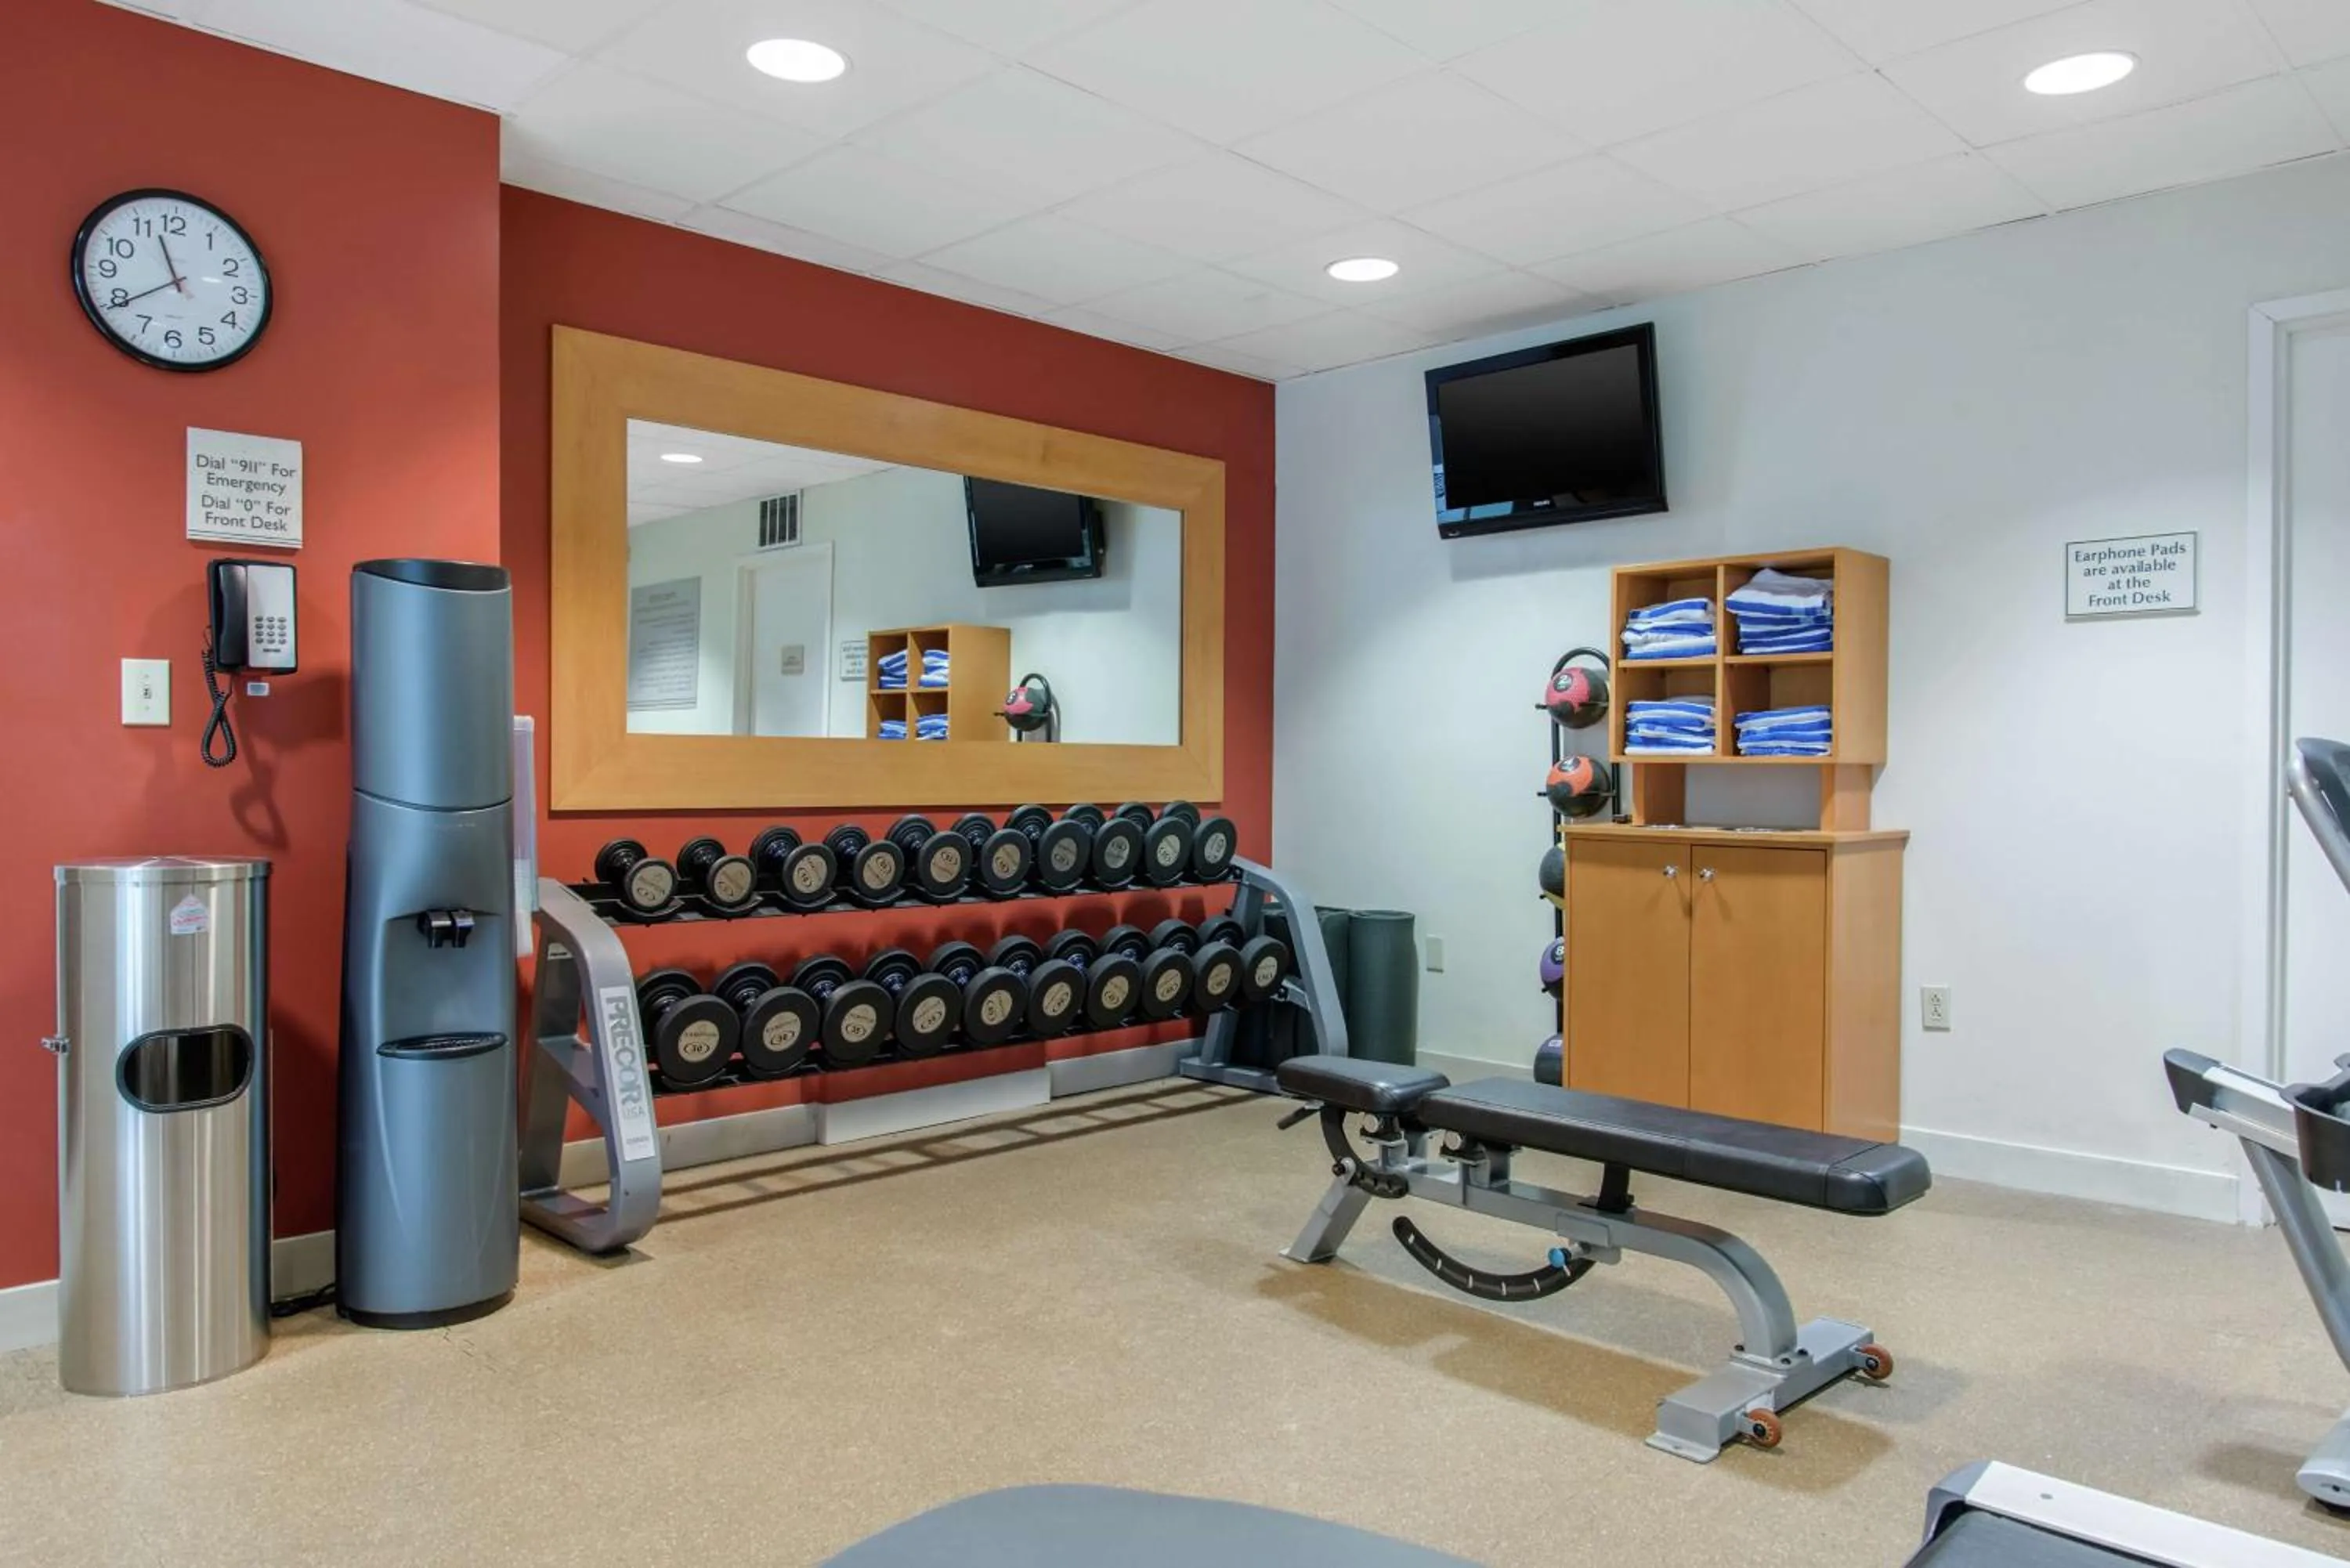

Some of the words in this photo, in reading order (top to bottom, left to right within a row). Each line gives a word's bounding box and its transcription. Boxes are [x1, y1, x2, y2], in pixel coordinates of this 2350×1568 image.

[132, 217, 150, 238] 11
[161, 213, 186, 237] 12
[107, 237, 134, 259] 10
[206, 232, 213, 251] 1
[98, 259, 117, 278] 9
[222, 258, 239, 277] 2
[110, 287, 129, 308] 8
[231, 286, 248, 305] 3
[136, 314, 153, 334] 7
[220, 310, 237, 329] 4
[164, 330, 183, 349] 6
[198, 327, 215, 345] 5
[197, 453, 225, 470] Dial
[271, 464, 297, 477] For
[206, 472, 287, 497] Emergency
[201, 494, 230, 510] Dial
[266, 501, 291, 516] For
[205, 511, 246, 527] Front
[251, 516, 287, 532] Desk
[2074, 547, 2146, 564] Earphone
[2150, 541, 2187, 556] Pads
[2083, 566, 2106, 577] are
[2111, 558, 2177, 575] available
[2107, 579, 2121, 590] at
[2127, 576, 2152, 588] the
[2088, 594, 2128, 607] Front
[2131, 590, 2171, 604] Desk
[606, 996, 642, 1105] PRECOR
